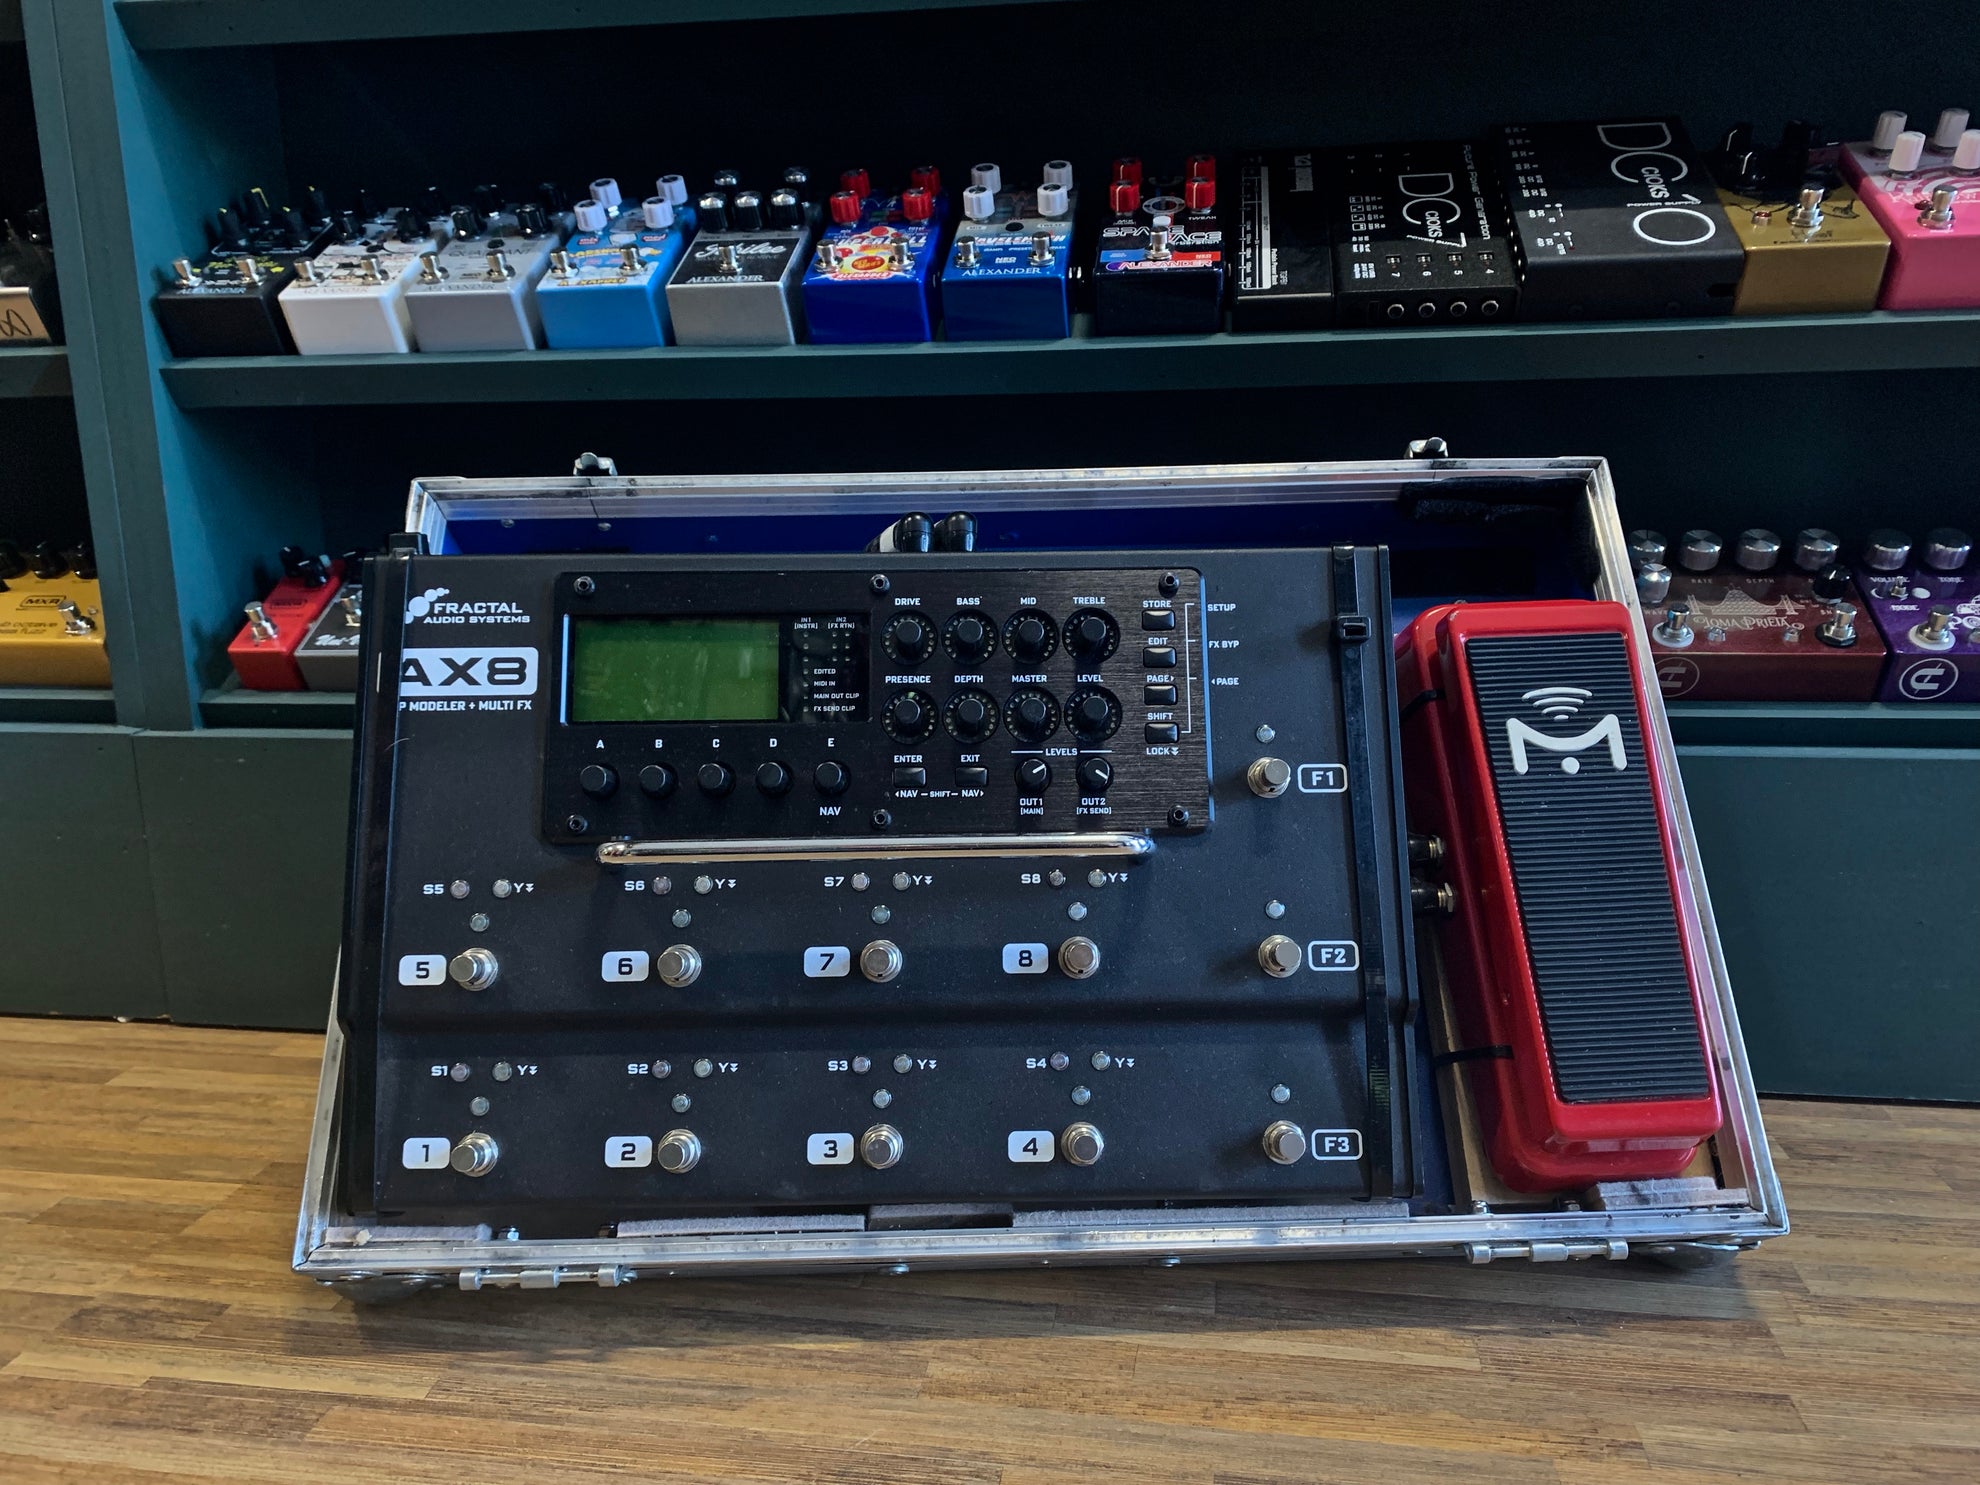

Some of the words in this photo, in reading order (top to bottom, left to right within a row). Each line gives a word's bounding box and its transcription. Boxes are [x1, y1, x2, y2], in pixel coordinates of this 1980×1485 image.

[1640, 166, 1670, 199] CIOKS
[1425, 210, 1443, 238] CIOKS
[1103, 225, 1184, 237] SPAE
[962, 268, 1042, 276] ALEXANDER
[686, 275, 764, 283] ALEXANDER
[1020, 597, 1037, 605] MID
[1073, 596, 1106, 605] TREBLE
[434, 602, 523, 614] FRACTAL
[1207, 603, 1236, 612] SETUP
[1209, 640, 1220, 649] FX
[1222, 640, 1239, 649] BYP
[401, 656, 527, 686] AX8
[885, 676, 931, 684] PRESENCE
[954, 675, 983, 683] DEPTH
[1011, 675, 1047, 683] MASTER
[1077, 674, 1103, 683] LEVEL
[1216, 677, 1239, 686] PAGE
[409, 701, 465, 711] MODELER
[478, 700, 514, 710] MULTI
[517, 700, 532, 710] FX
[1147, 712, 1173, 720] SHIFT
[596, 740, 604, 749] A
[655, 740, 662, 748] B
[712, 739, 720, 748] C
[769, 738, 777, 747] D
[828, 738, 834, 747] E
[1045, 748, 1078, 756] LEVELS
[1146, 747, 1170, 755] LOCK
[894, 755, 922, 763] ENTER
[960, 754, 980, 762] EXIT
[1311, 771, 1334, 786] F1
[900, 790, 918, 798] NAV
[961, 790, 980, 798] NAV
[1019, 798, 1043, 806] OUT1
[1081, 798, 1106, 806] OUT2
[820, 807, 841, 816] NAV
[824, 876, 844, 887] S7
[912, 875, 924, 885] Y
[1021, 874, 1041, 884] S8
[1107, 873, 1119, 882] Y
[514, 884, 525, 893] Y
[624, 880, 645, 891] S6
[715, 879, 727, 889] Y
[423, 884, 444, 895] S5
[1018, 950, 1033, 967] 8
[1320, 948, 1346, 964] F2
[618, 958, 633, 975] 6
[820, 953, 835, 971] 7
[415, 961, 430, 978] 5
[718, 1063, 730, 1073] Y
[828, 1061, 848, 1071] S3
[917, 1059, 928, 1069] Y
[1026, 1058, 1047, 1069] S4
[1115, 1058, 1126, 1068] Y
[431, 1066, 448, 1076] S1
[517, 1065, 529, 1075] Y
[628, 1064, 648, 1074] S2
[823, 1140, 838, 1158] 3
[1022, 1138, 1038, 1155] 4
[1324, 1137, 1350, 1152] F3
[422, 1145, 429, 1162] 1
[620, 1143, 636, 1160] 2
